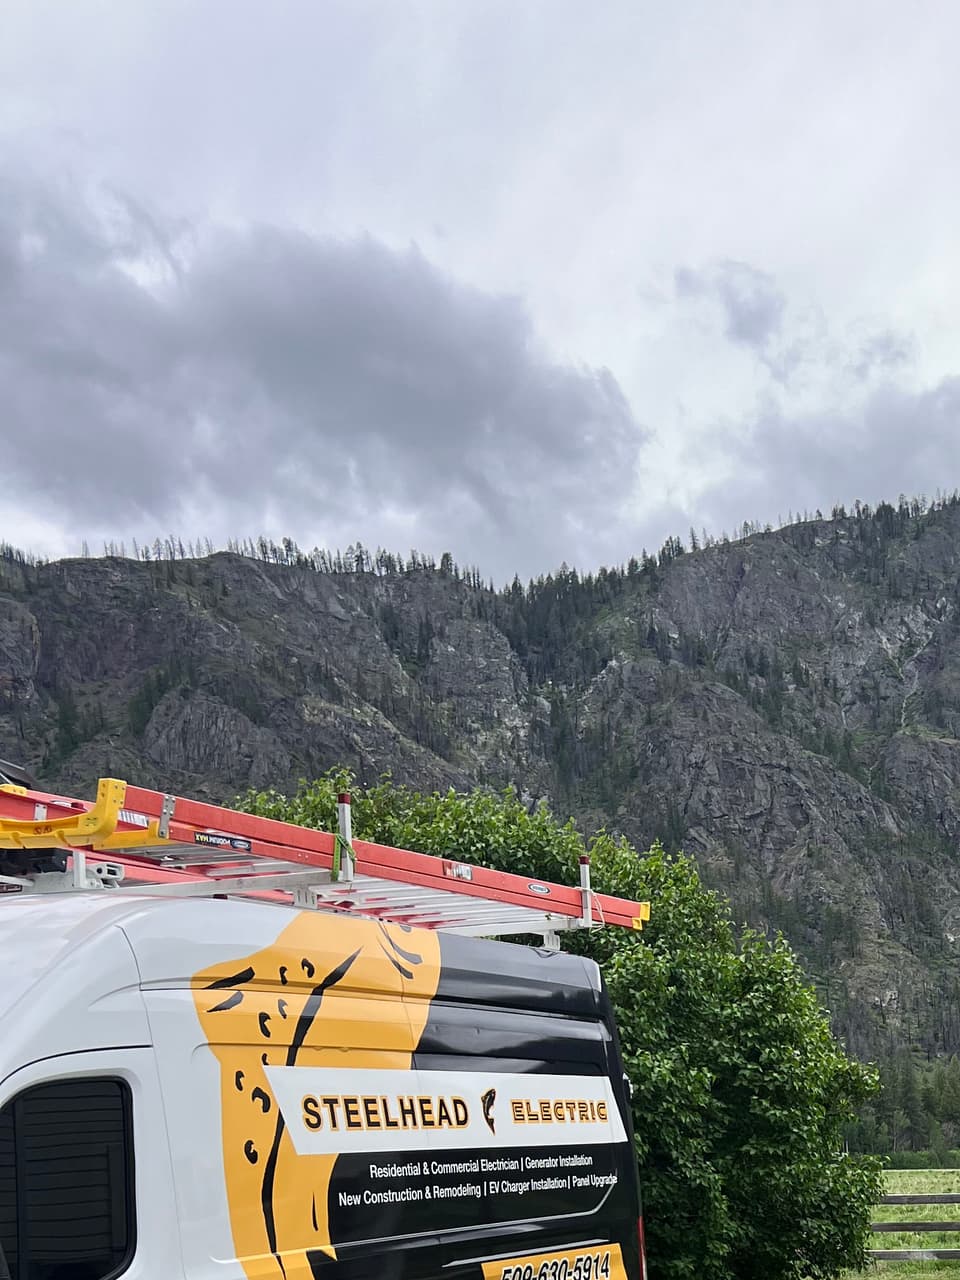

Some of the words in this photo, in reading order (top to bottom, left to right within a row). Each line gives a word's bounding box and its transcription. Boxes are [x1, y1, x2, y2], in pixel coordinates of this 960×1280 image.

[301, 1095, 471, 1132] STEELHEAD
[511, 1098, 609, 1125] ELECTRIC
[369, 1162, 421, 1179] Residential
[423, 1161, 430, 1176] &
[431, 1159, 480, 1175] Commercial
[481, 1157, 519, 1172] Electrician
[525, 1156, 558, 1169] Generator
[559, 1154, 593, 1167] Installation
[338, 1192, 362, 1207] New
[363, 1187, 423, 1205] Construction
[425, 1185, 432, 1200] &
[433, 1181, 482, 1199] Remodeling
[489, 1181, 500, 1194] EV
[501, 1180, 530, 1195] Charger
[531, 1176, 567, 1191] Installation
[572, 1174, 590, 1188] Panel
[591, 1173, 618, 1188] Upgrade
